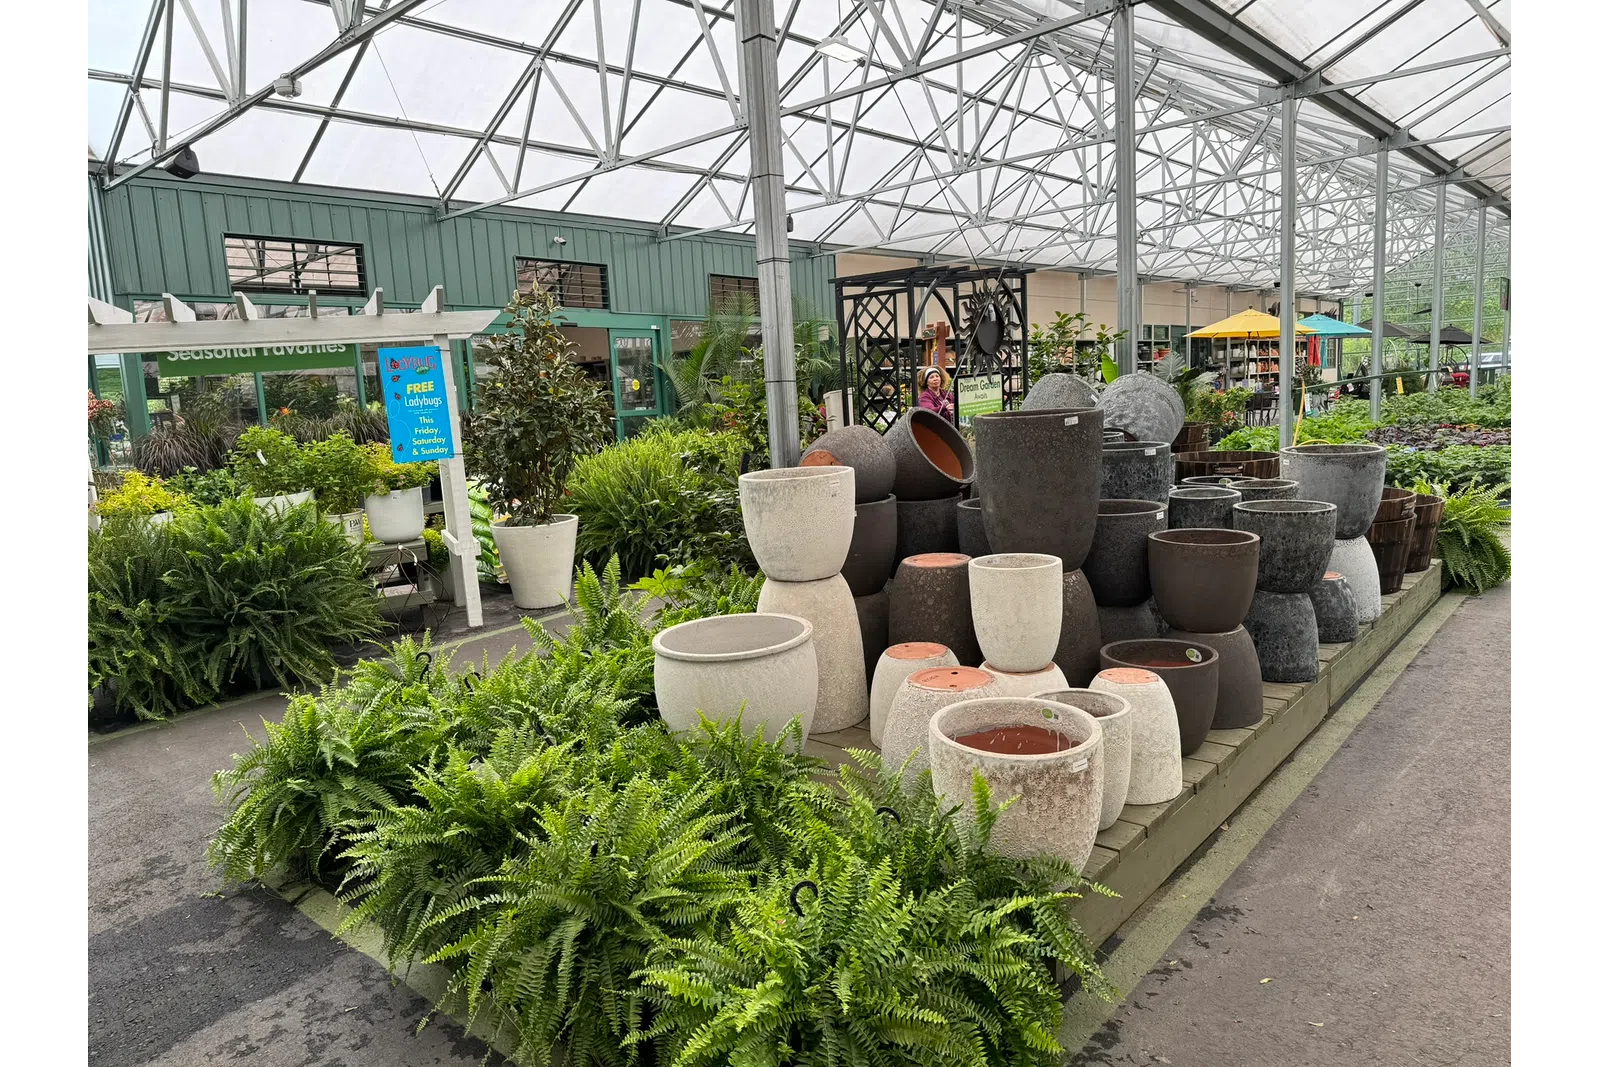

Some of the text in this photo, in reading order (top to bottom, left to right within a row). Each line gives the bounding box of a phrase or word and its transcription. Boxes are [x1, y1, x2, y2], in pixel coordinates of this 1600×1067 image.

[167, 344, 346, 361] Seasonal Favorites
[406, 381, 434, 394] FREE
[960, 378, 1001, 393] Dream Garden
[404, 394, 443, 408] Ladybugs
[419, 416, 434, 424] This
[414, 426, 441, 435] Friday,
[412, 435, 446, 446] Saturday
[412, 445, 449, 456] & Sunday
